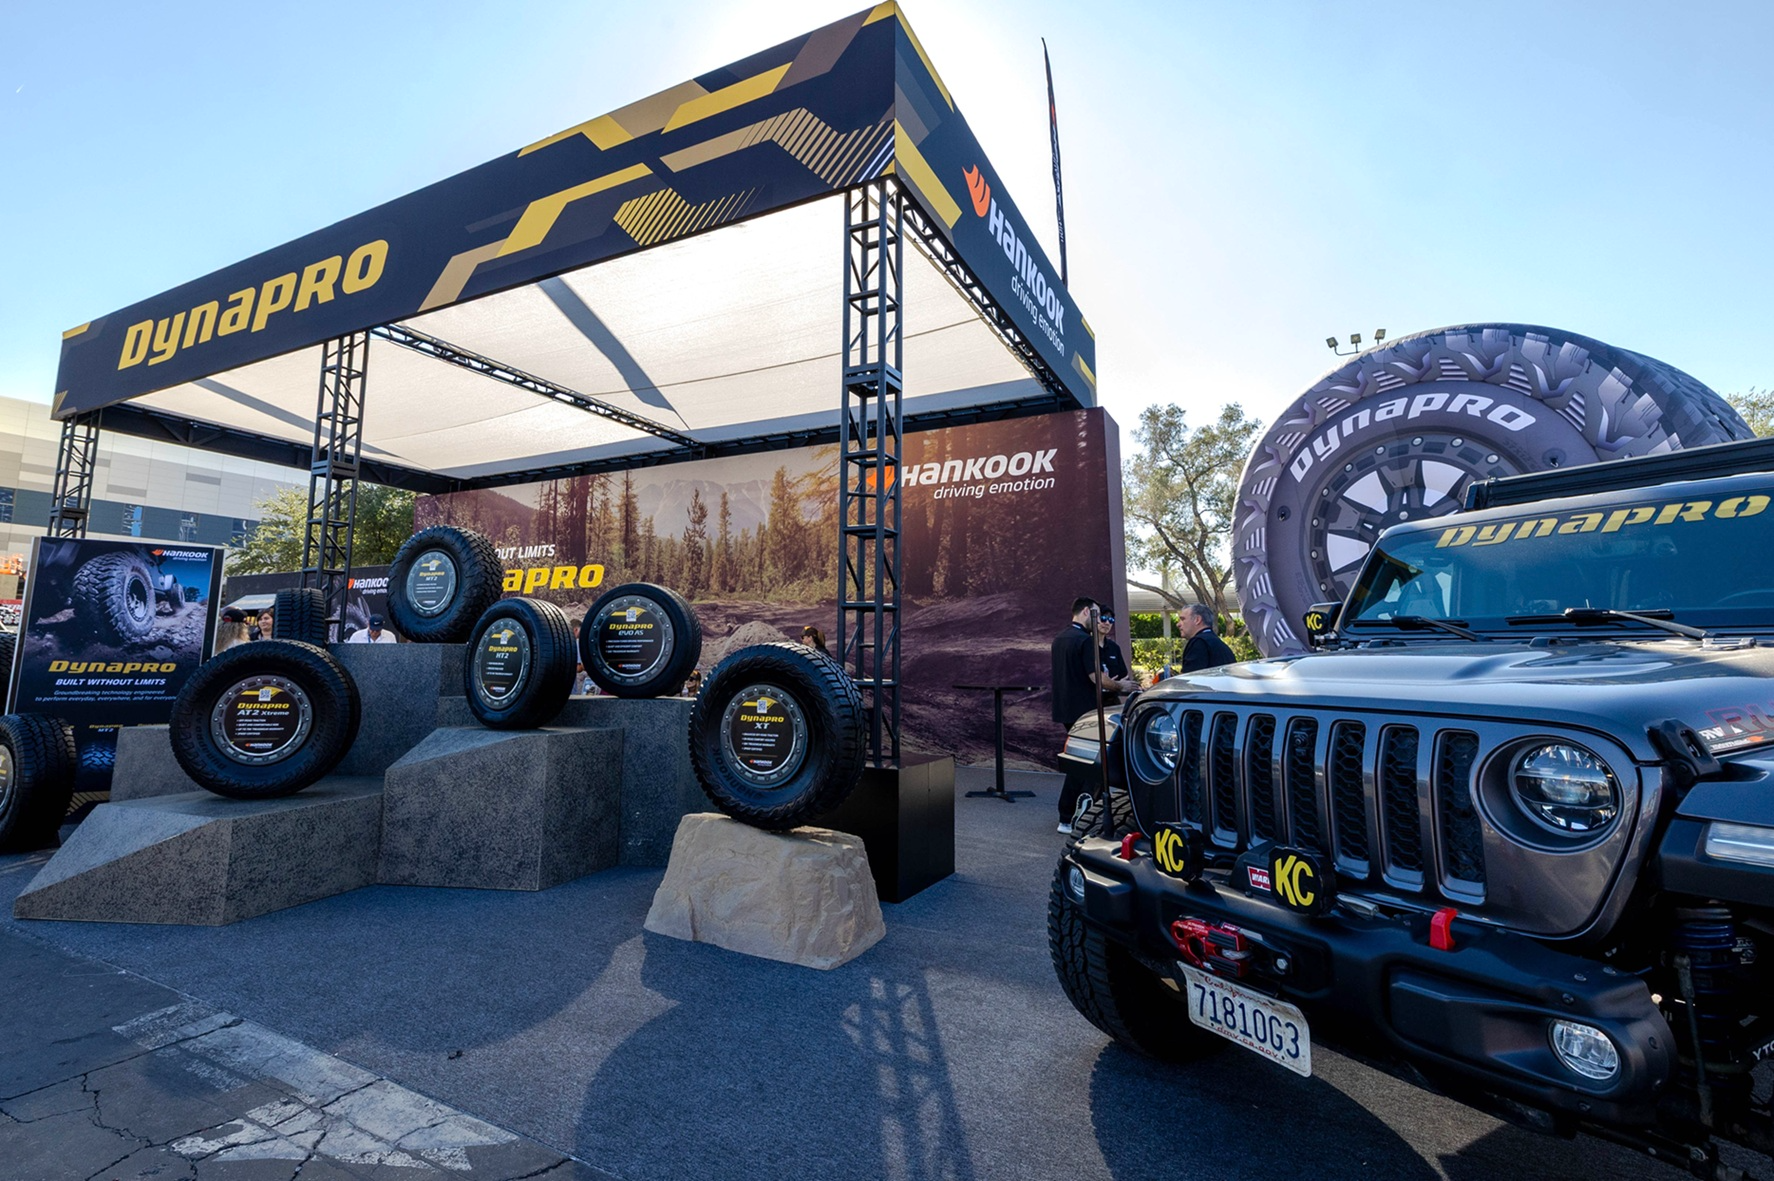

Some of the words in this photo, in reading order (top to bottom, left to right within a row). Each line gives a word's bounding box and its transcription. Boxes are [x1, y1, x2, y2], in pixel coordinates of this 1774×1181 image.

[1011, 275, 1037, 325] driving
[1038, 312, 1065, 357] emotion
[933, 484, 985, 500] driving
[988, 477, 1055, 495] emotion
[518, 544, 555, 559] LIMITS
[1306, 612, 1323, 631] KC
[1155, 828, 1184, 873] KC
[1274, 854, 1314, 906] KC
[1193, 982, 1300, 1060] 71810G3
[1216, 1026, 1279, 1059] dmv.ca.gov
